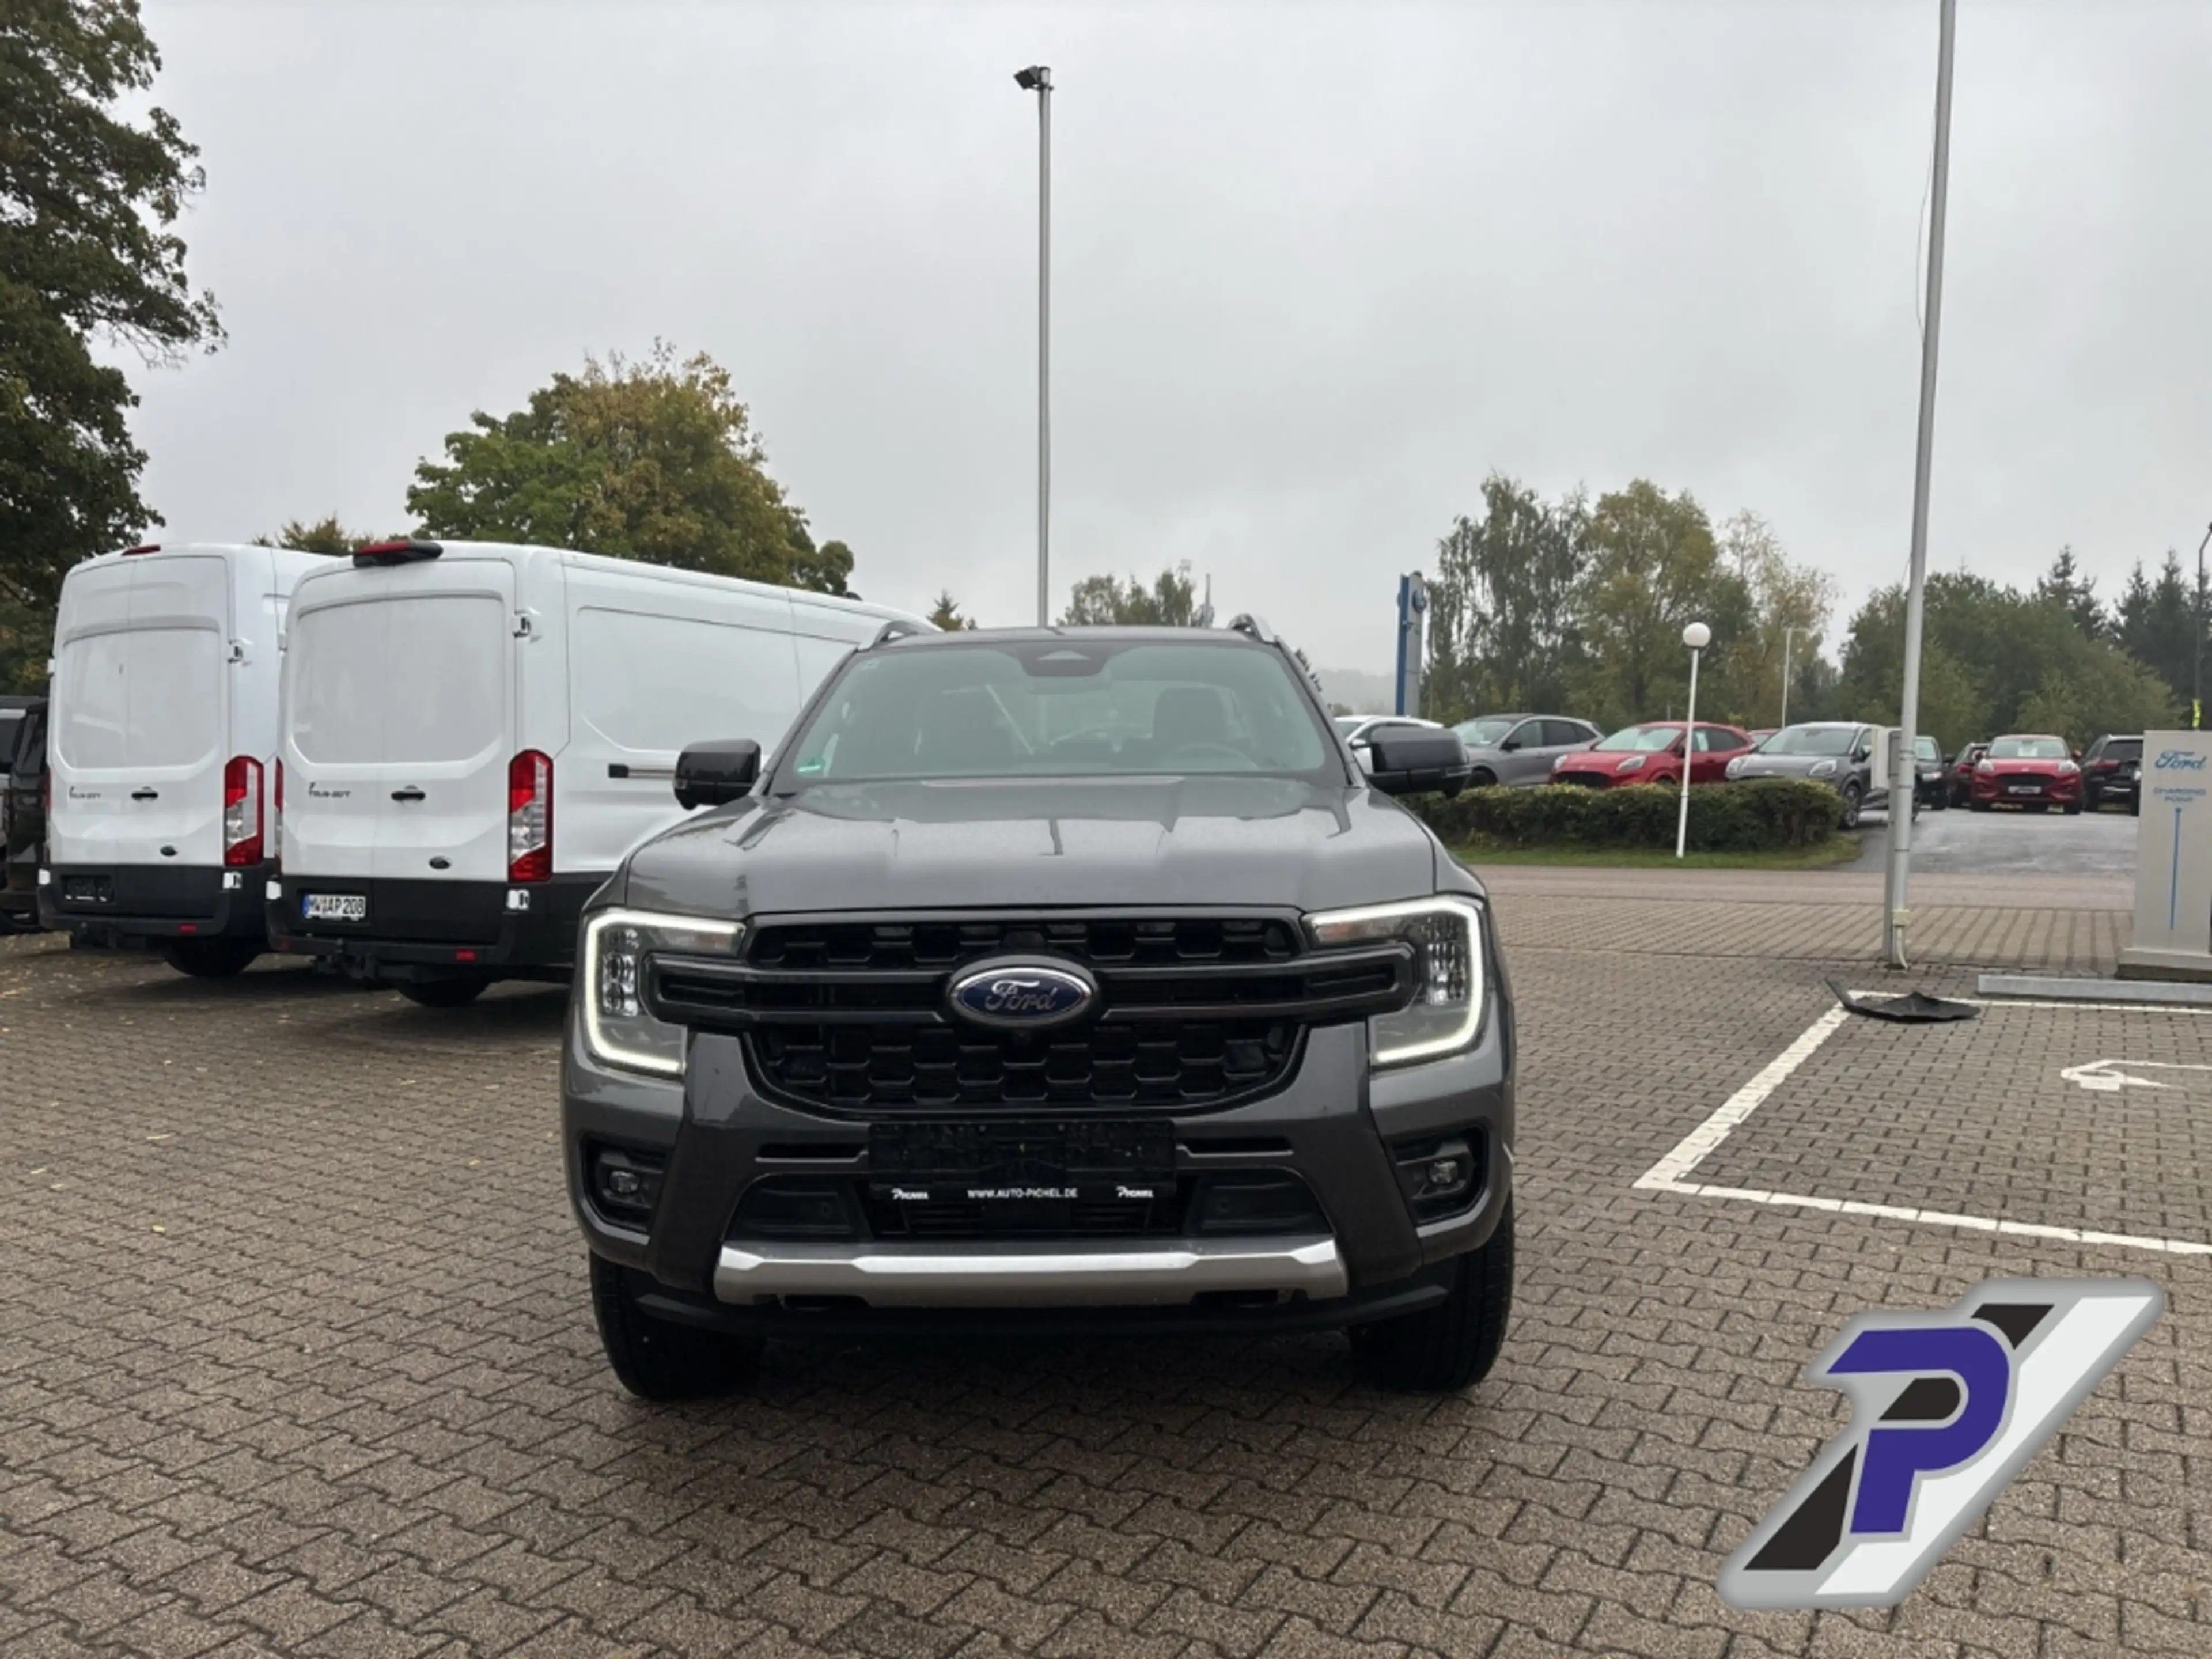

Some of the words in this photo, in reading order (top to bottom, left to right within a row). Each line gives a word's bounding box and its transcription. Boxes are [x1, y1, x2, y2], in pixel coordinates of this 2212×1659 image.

[2154, 750, 2207, 770] Ford
[984, 980, 1058, 1010] Ford
[967, 1188, 1078, 1199] WWW.AUTO-PICHEL.DE
